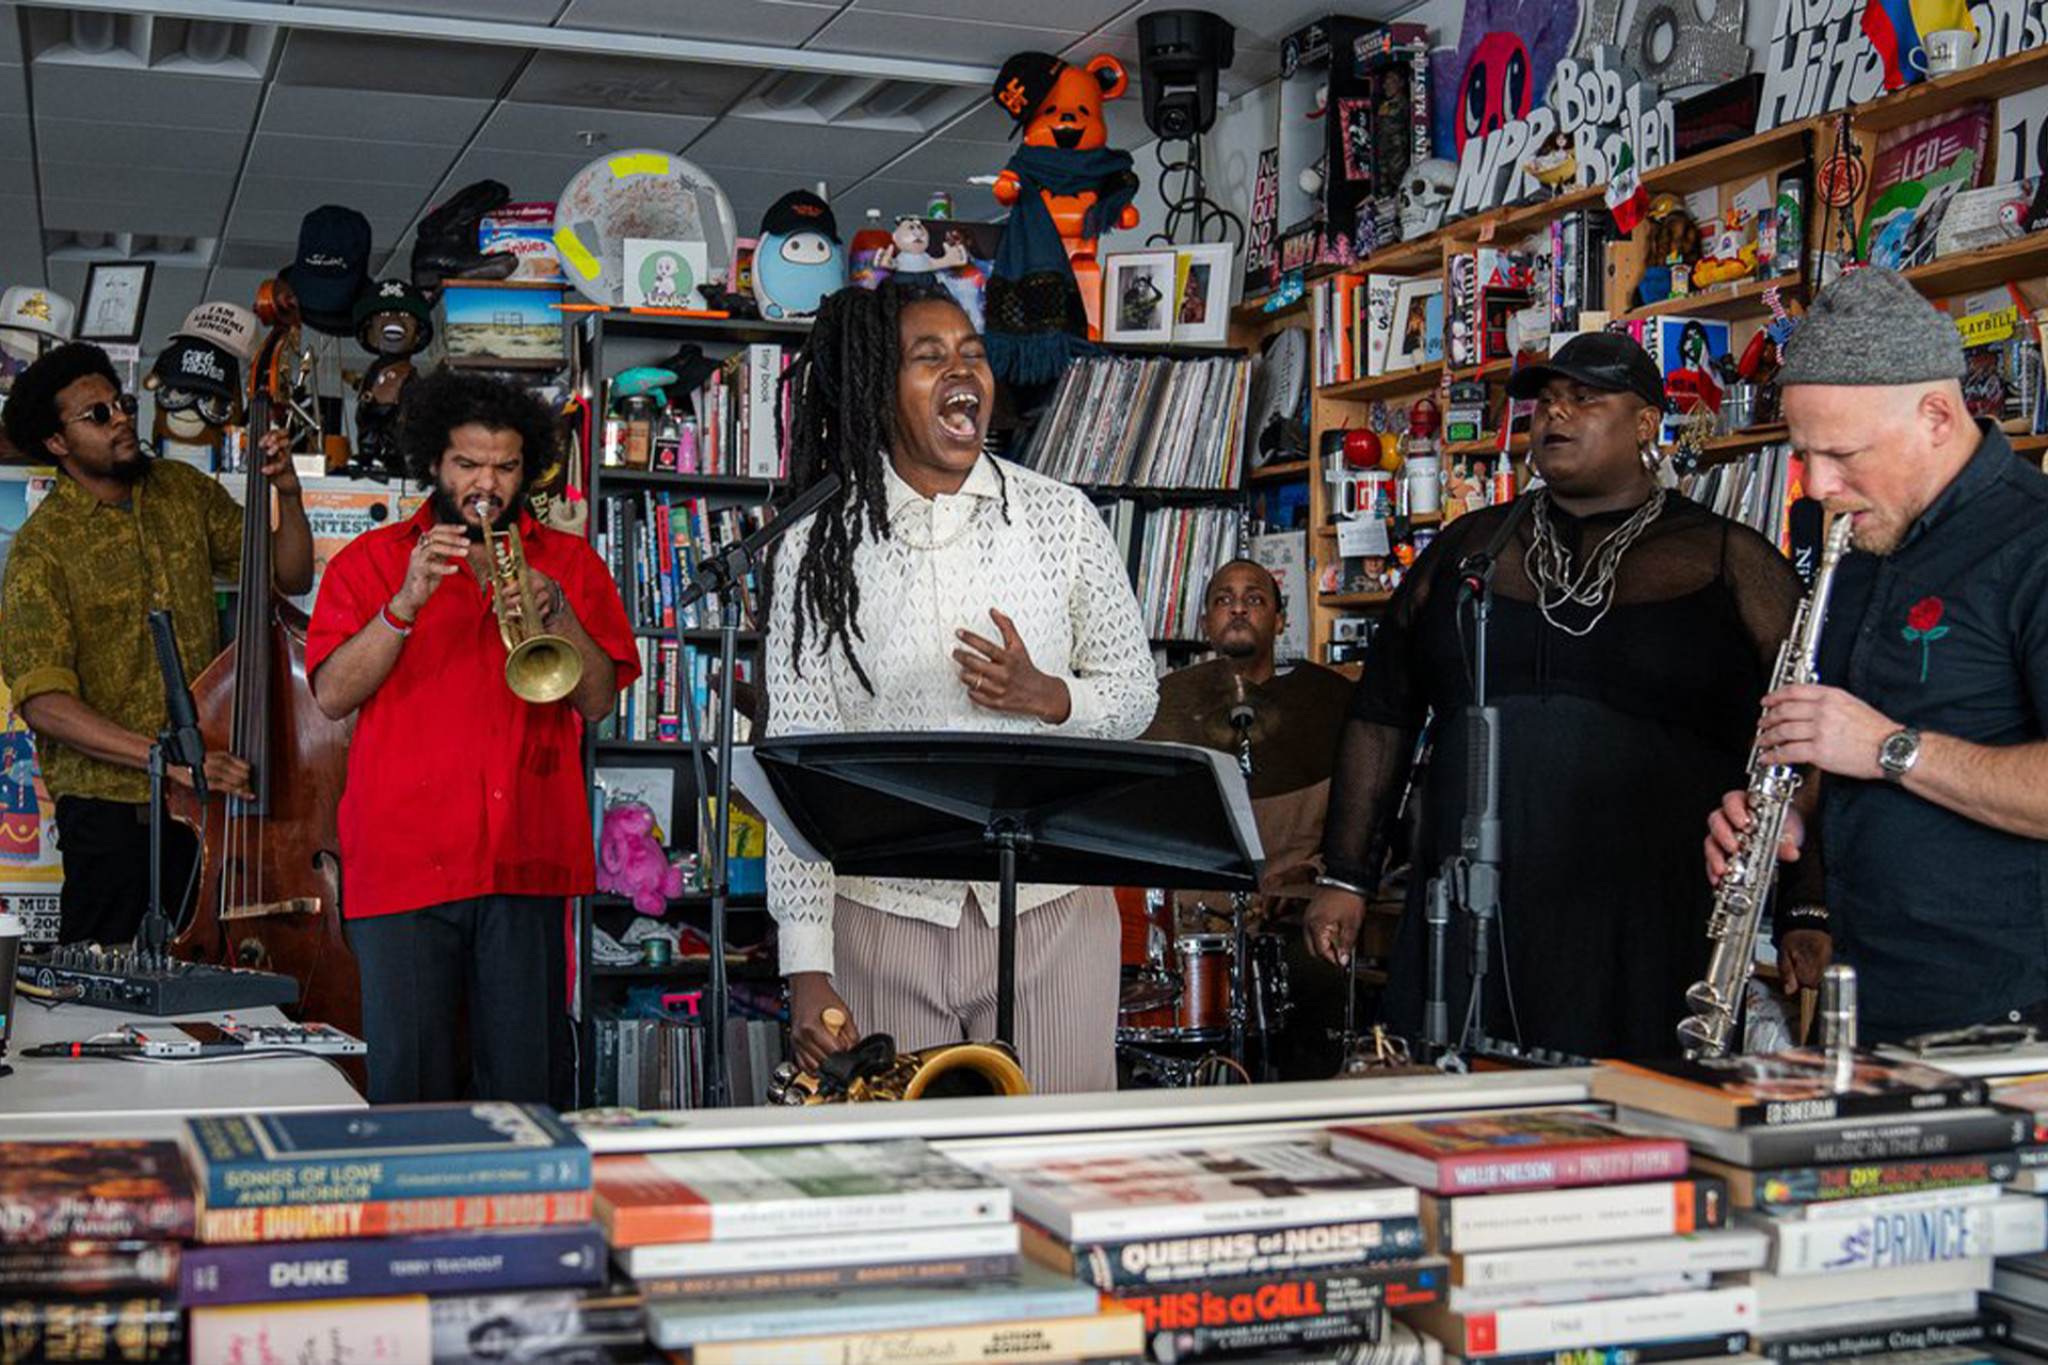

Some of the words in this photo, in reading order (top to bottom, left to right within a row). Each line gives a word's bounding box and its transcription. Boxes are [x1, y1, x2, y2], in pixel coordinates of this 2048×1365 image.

[1413, 52, 1427, 117] MASTER
[1556, 44, 1623, 134] Bob
[1574, 82, 1676, 189] Boilen
[1446, 107, 1556, 216] NPR
[197, 322, 232, 337] SINGH
[216, 306, 235, 319] AM
[760, 373, 772, 404] book
[1766, 1102, 1785, 1125] ED
[1784, 1099, 1837, 1123] SHEERAN
[225, 1168, 296, 1190] SONGS
[299, 1165, 328, 1184] OF
[331, 1162, 384, 1183] LOVE
[1454, 1164, 1498, 1186] WILLIE
[1499, 1161, 1556, 1183] NELSON
[1580, 1152, 1629, 1177] PRETTY
[204, 1207, 255, 1244] MIKE
[263, 1202, 364, 1240] DOUGHTY
[1872, 1206, 1971, 1269] PRINCE
[1121, 1233, 1257, 1276] QUEENS
[1257, 1232, 1283, 1255] of
[1285, 1221, 1381, 1256] NOISE
[269, 1258, 348, 1287] DUKE
[1120, 1291, 1199, 1331] THIS
[1202, 1289, 1227, 1324] is
[1230, 1294, 1253, 1320] a
[1255, 1281, 1323, 1319] CALL
